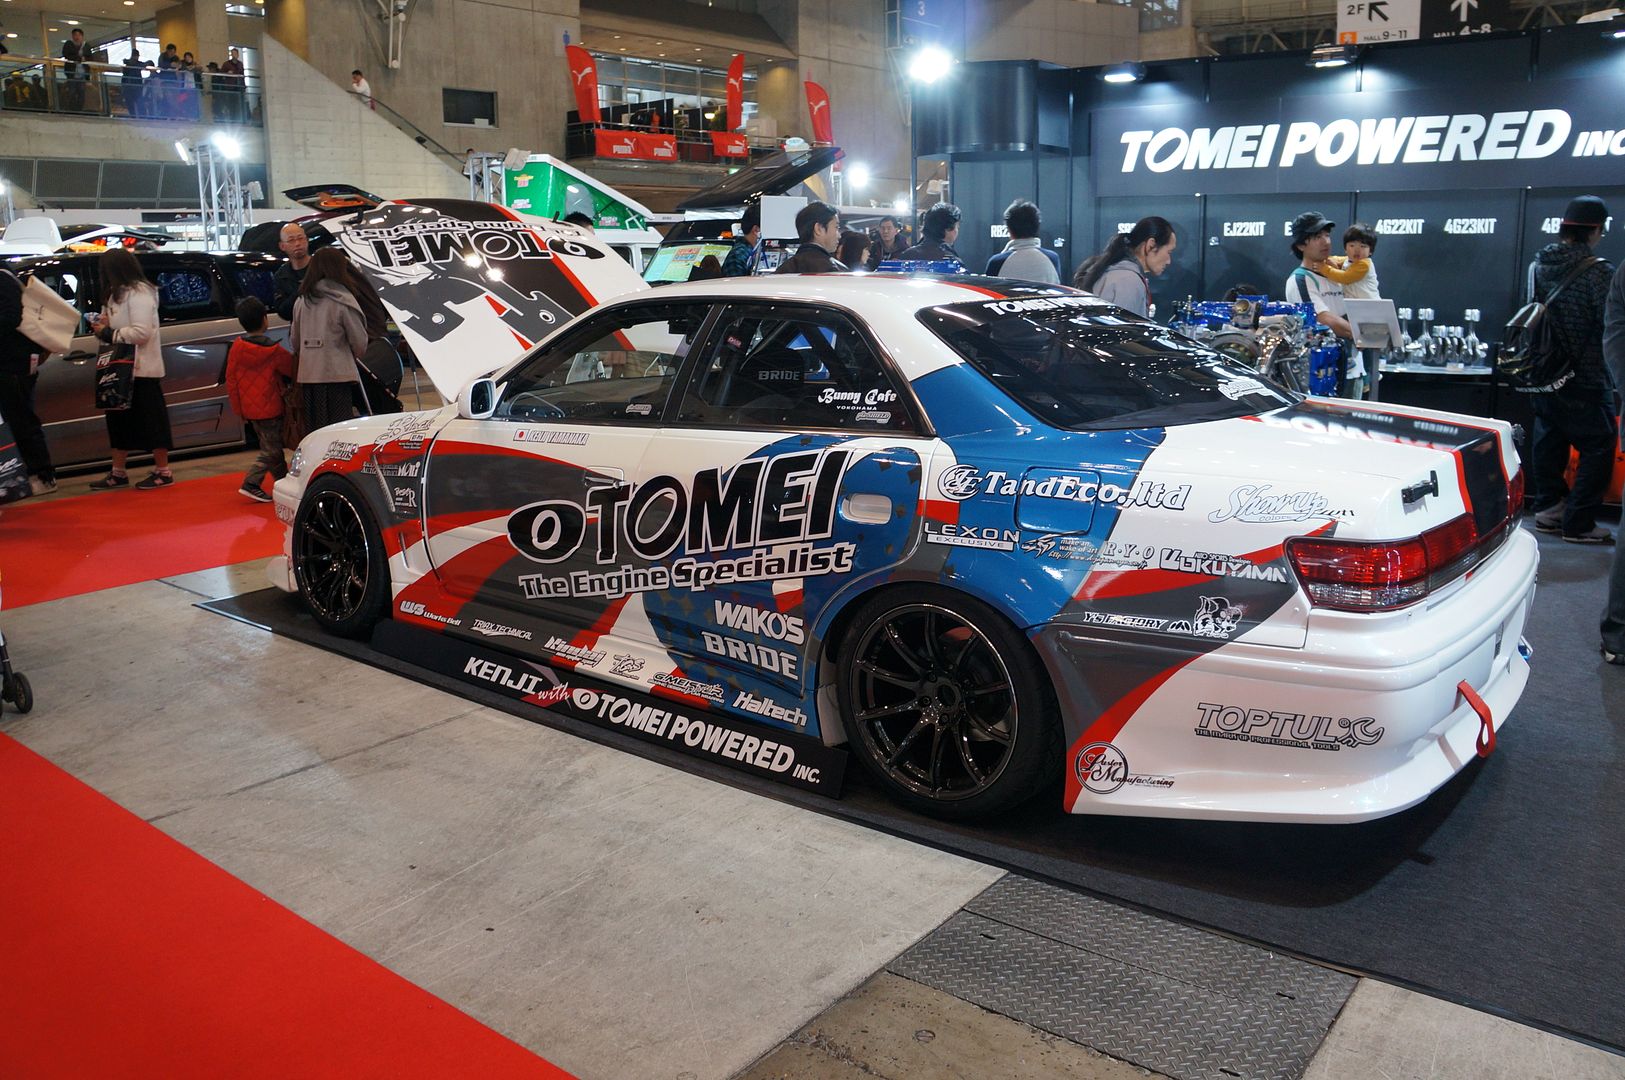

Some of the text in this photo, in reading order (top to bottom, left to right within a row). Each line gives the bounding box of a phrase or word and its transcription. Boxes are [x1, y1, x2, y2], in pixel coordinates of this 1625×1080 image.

[1347, 4, 1366, 15] 2F
[1120, 123, 1281, 173] TOMEI
[1279, 109, 1573, 167] POWERED
[1223, 222, 1266, 236] EJ22KIT
[758, 370, 800, 381] BRIDE
[864, 389, 897, 405] Cafe
[924, 522, 1022, 543] LEXON
[935, 537, 1005, 548] EXCLUSIVE
[518, 543, 857, 600] The Engine Specialist
[714, 599, 805, 646] WAKO'S
[1103, 613, 1169, 630] FACTORY
[701, 631, 799, 680] BRIDE
[732, 690, 808, 726] Haltech
[463, 656, 543, 695] KENJI
[537, 682, 570, 703] with
[596, 693, 675, 738] TOMEI
[668, 720, 795, 773] POWERED
[792, 763, 821, 784] INC.
[1250, 735, 1311, 749] PROFESSIONAL
[1311, 742, 1341, 751] TOOLS
